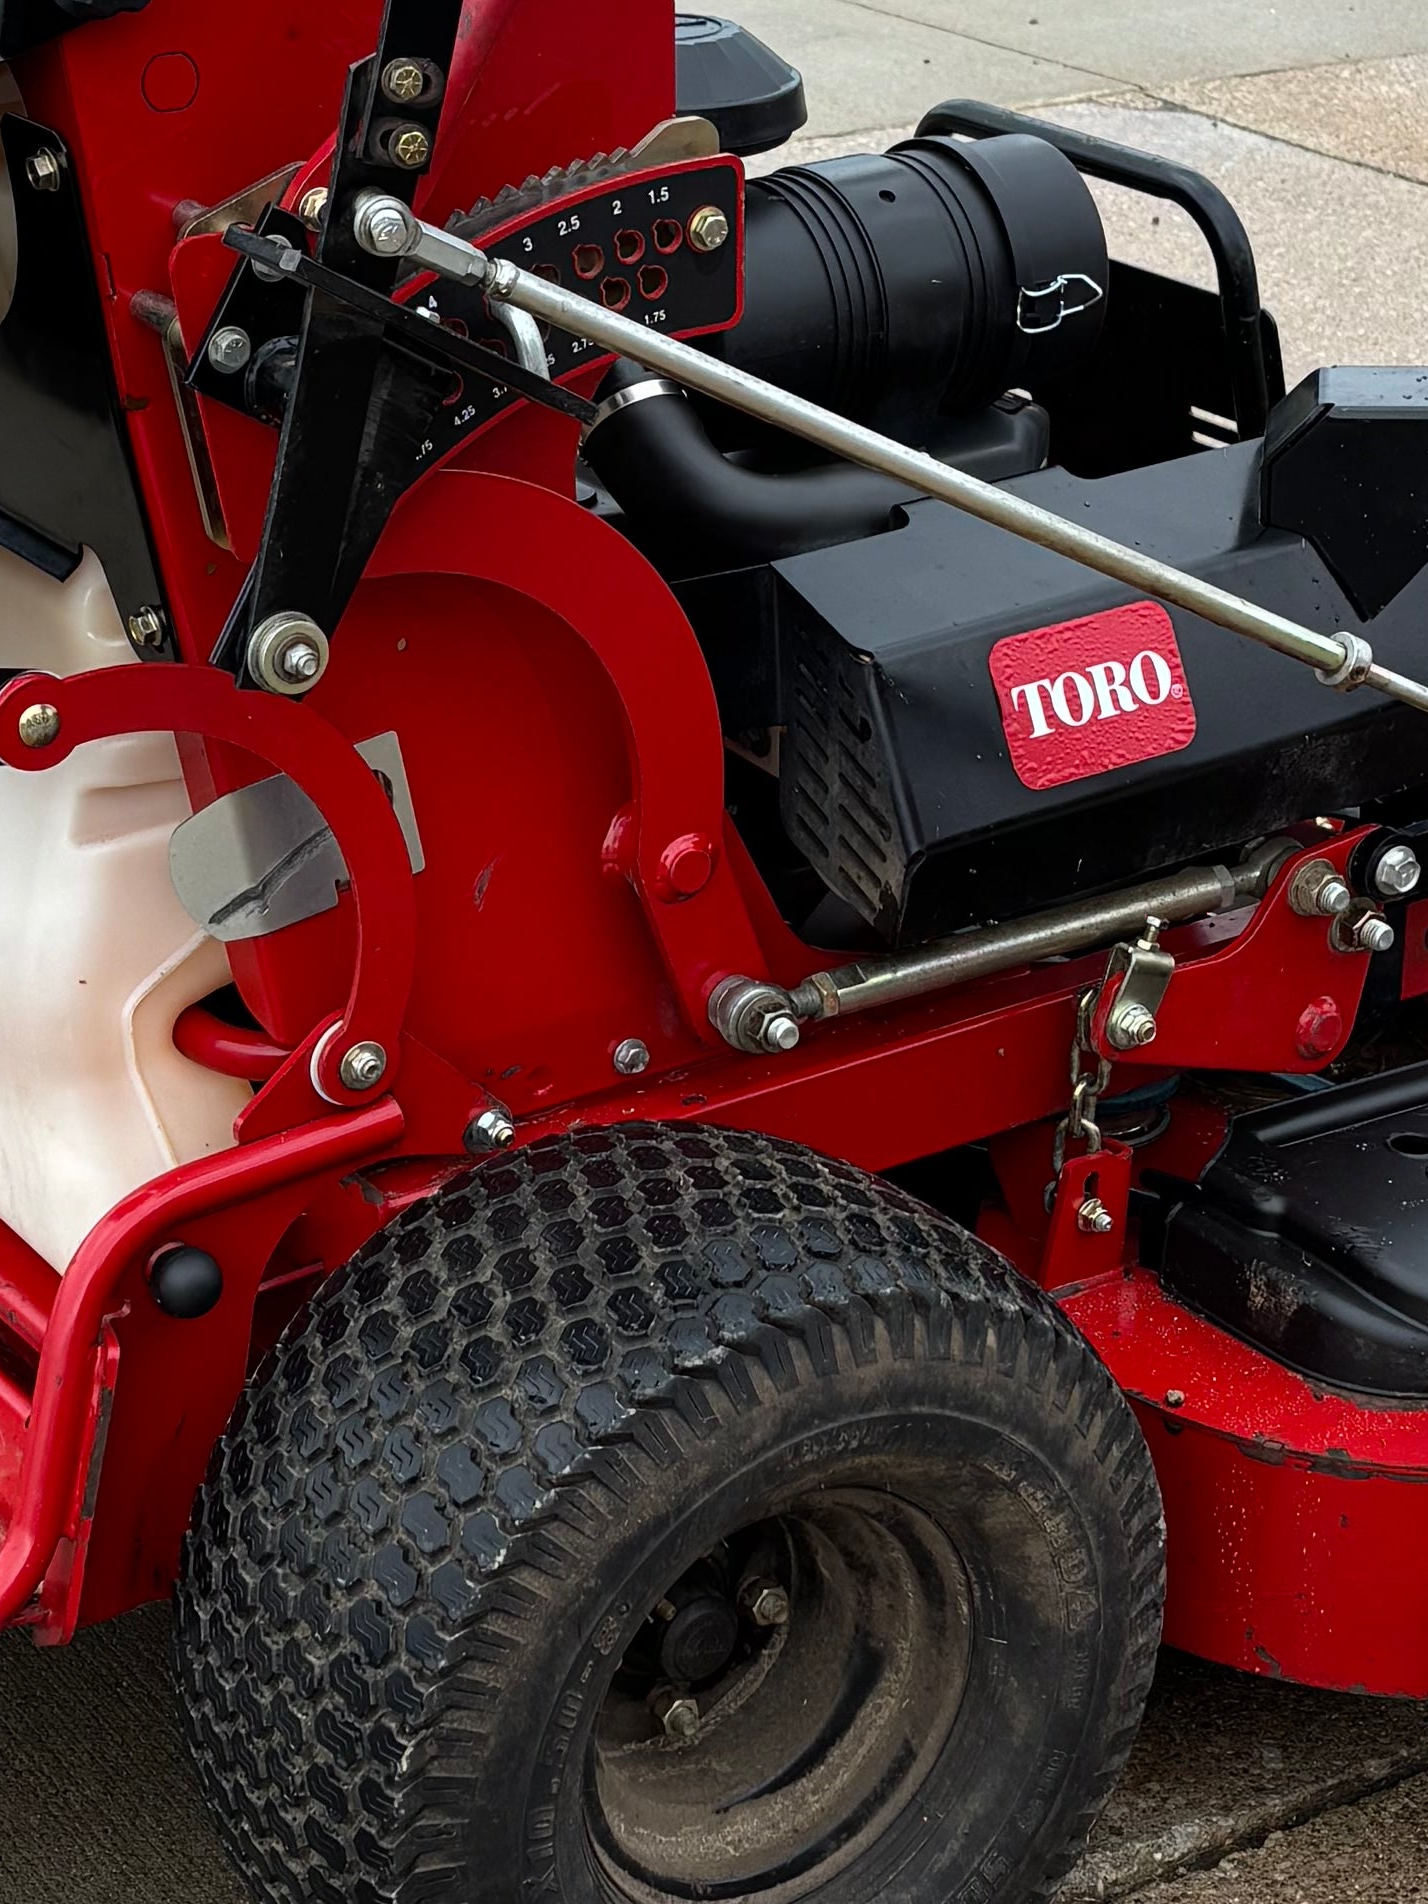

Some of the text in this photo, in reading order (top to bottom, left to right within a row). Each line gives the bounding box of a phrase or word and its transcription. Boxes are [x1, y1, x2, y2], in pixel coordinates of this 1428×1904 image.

[428, 186, 670, 309] 4 3 2.5 2 1.5
[454, 405, 476, 426] 4.25
[644, 309, 667, 326] 1.75
[1011, 650, 1172, 739] TORO
